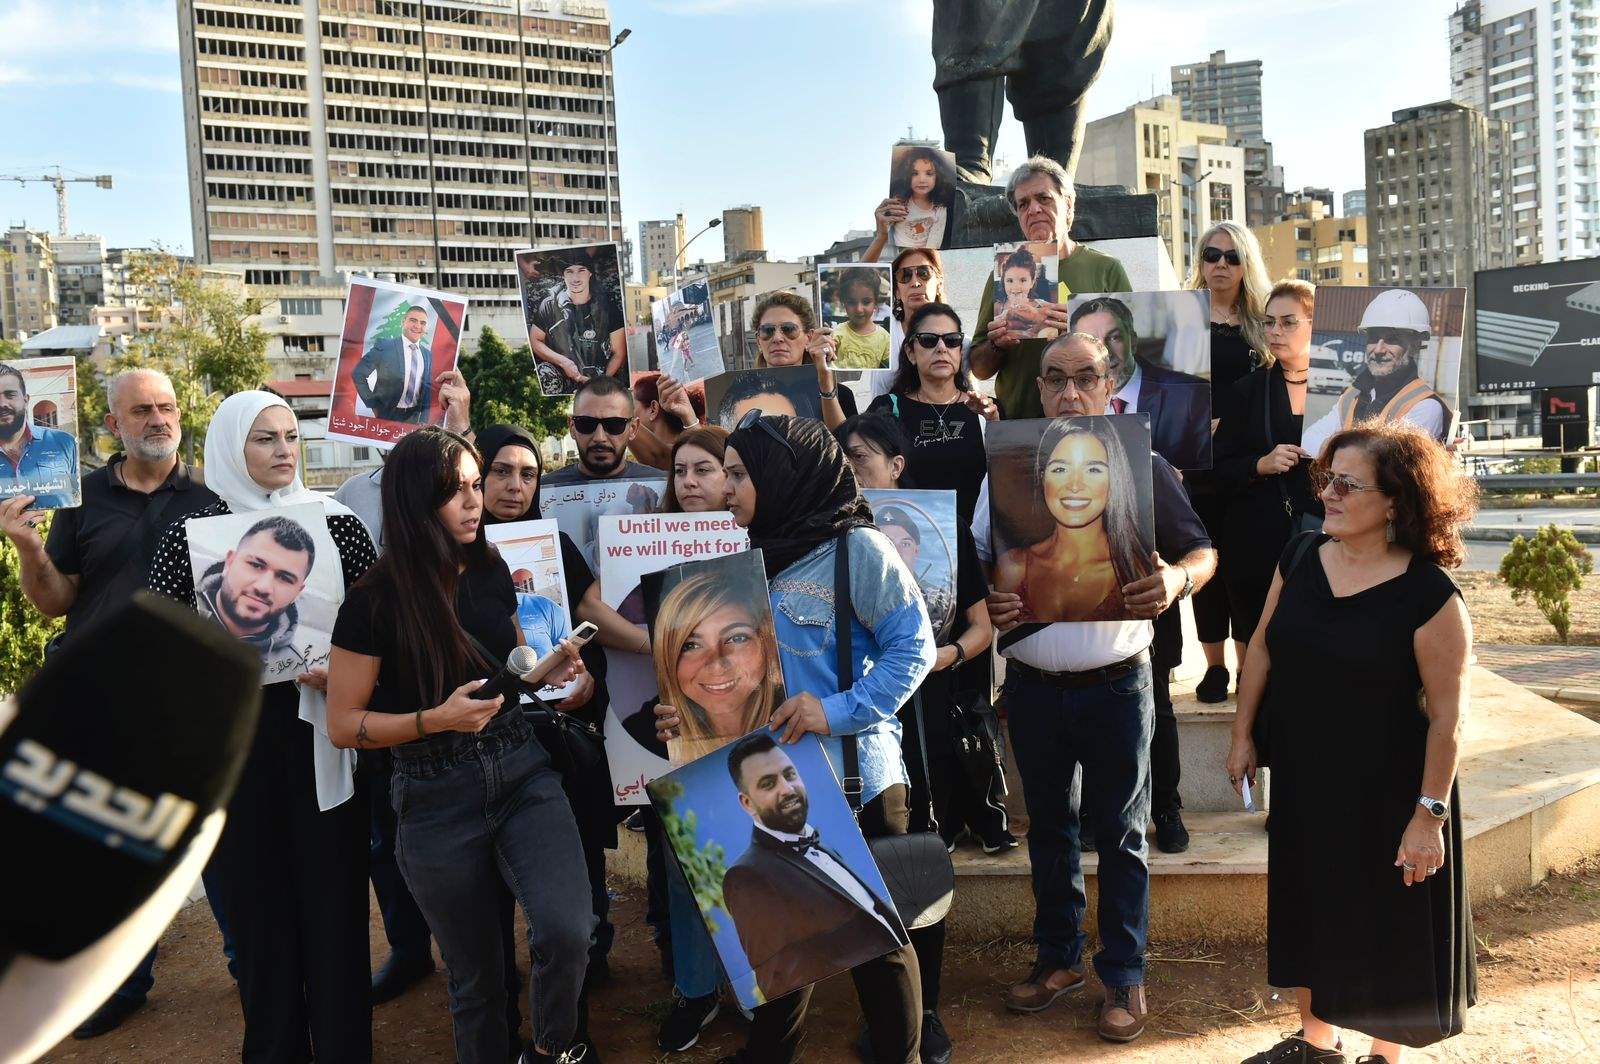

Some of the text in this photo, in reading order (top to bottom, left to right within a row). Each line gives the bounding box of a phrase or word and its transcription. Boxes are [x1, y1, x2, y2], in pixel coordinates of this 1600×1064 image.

[1512, 282, 1549, 293] DECKING
[348, 418, 369, 432] أجود
[371, 423, 390, 436] جواد
[920, 419, 966, 437] EA7
[33, 478, 67, 494] الشهيد
[618, 518, 738, 534] Until we meet
[607, 544, 632, 557] we
[636, 540, 667, 556] will
[671, 540, 711, 557] fight
[714, 538, 740, 553] for
[3, 738, 198, 849] الجديد
